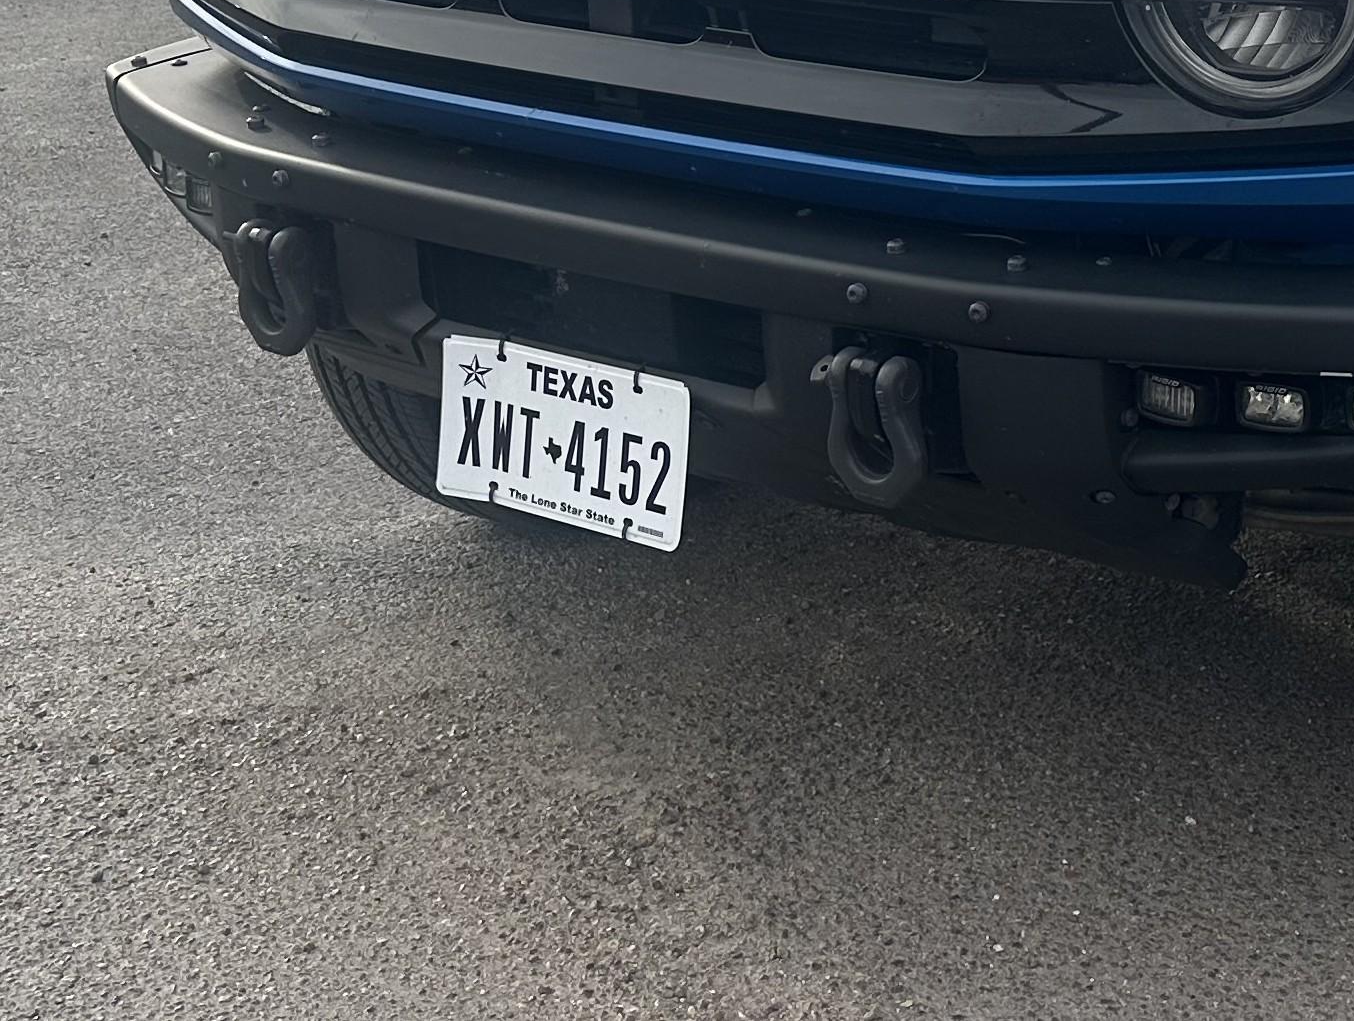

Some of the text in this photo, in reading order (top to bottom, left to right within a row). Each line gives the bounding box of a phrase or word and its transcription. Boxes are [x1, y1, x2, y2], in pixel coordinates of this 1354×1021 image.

[526, 361, 614, 410] TEXAS
[456, 395, 672, 515] XWT 4152
[508, 487, 616, 526] The Lone Star State
